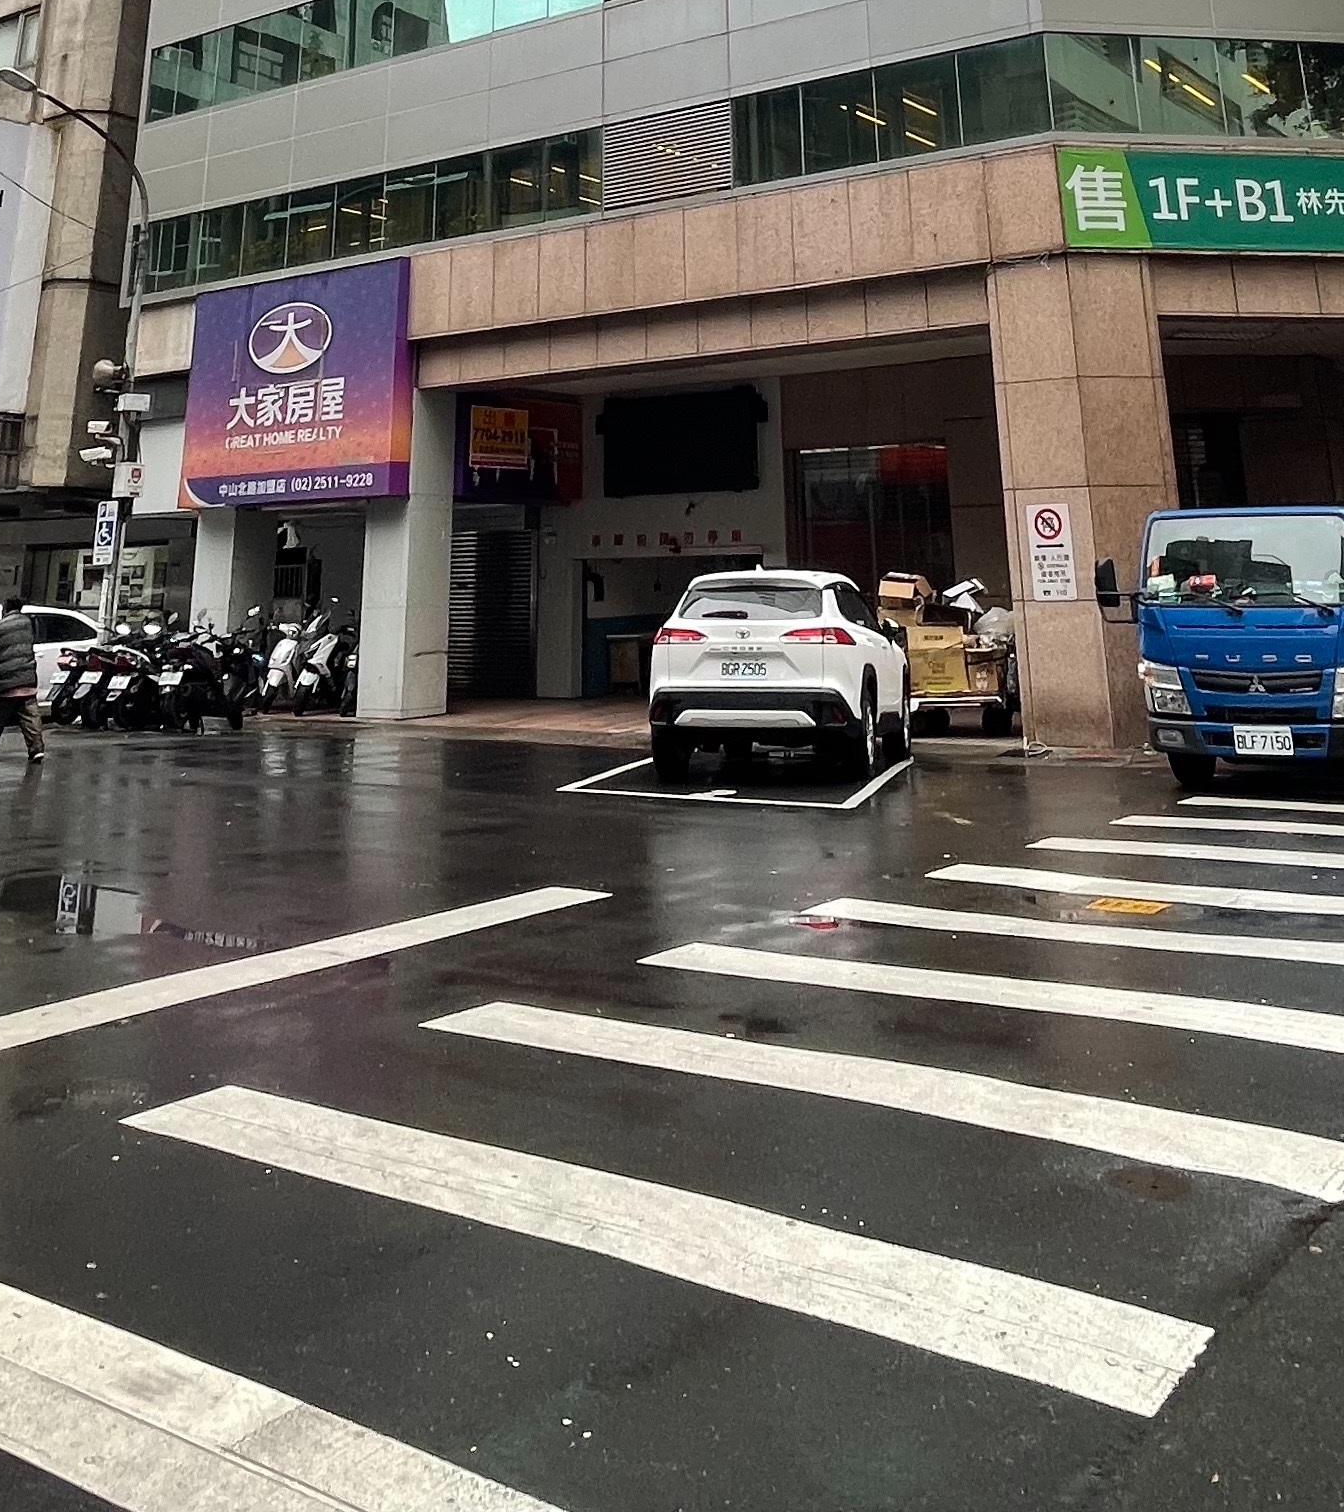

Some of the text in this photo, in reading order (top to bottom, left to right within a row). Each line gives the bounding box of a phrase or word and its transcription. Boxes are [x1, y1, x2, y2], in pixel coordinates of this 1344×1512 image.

[1064, 163, 1128, 232] 售
[1147, 176, 1295, 223] 1F+B1
[226, 376, 345, 431] 大家房屋
[225, 425, 343, 450] GREAT HOME REALTY
[290, 475, 312, 493] (02)
